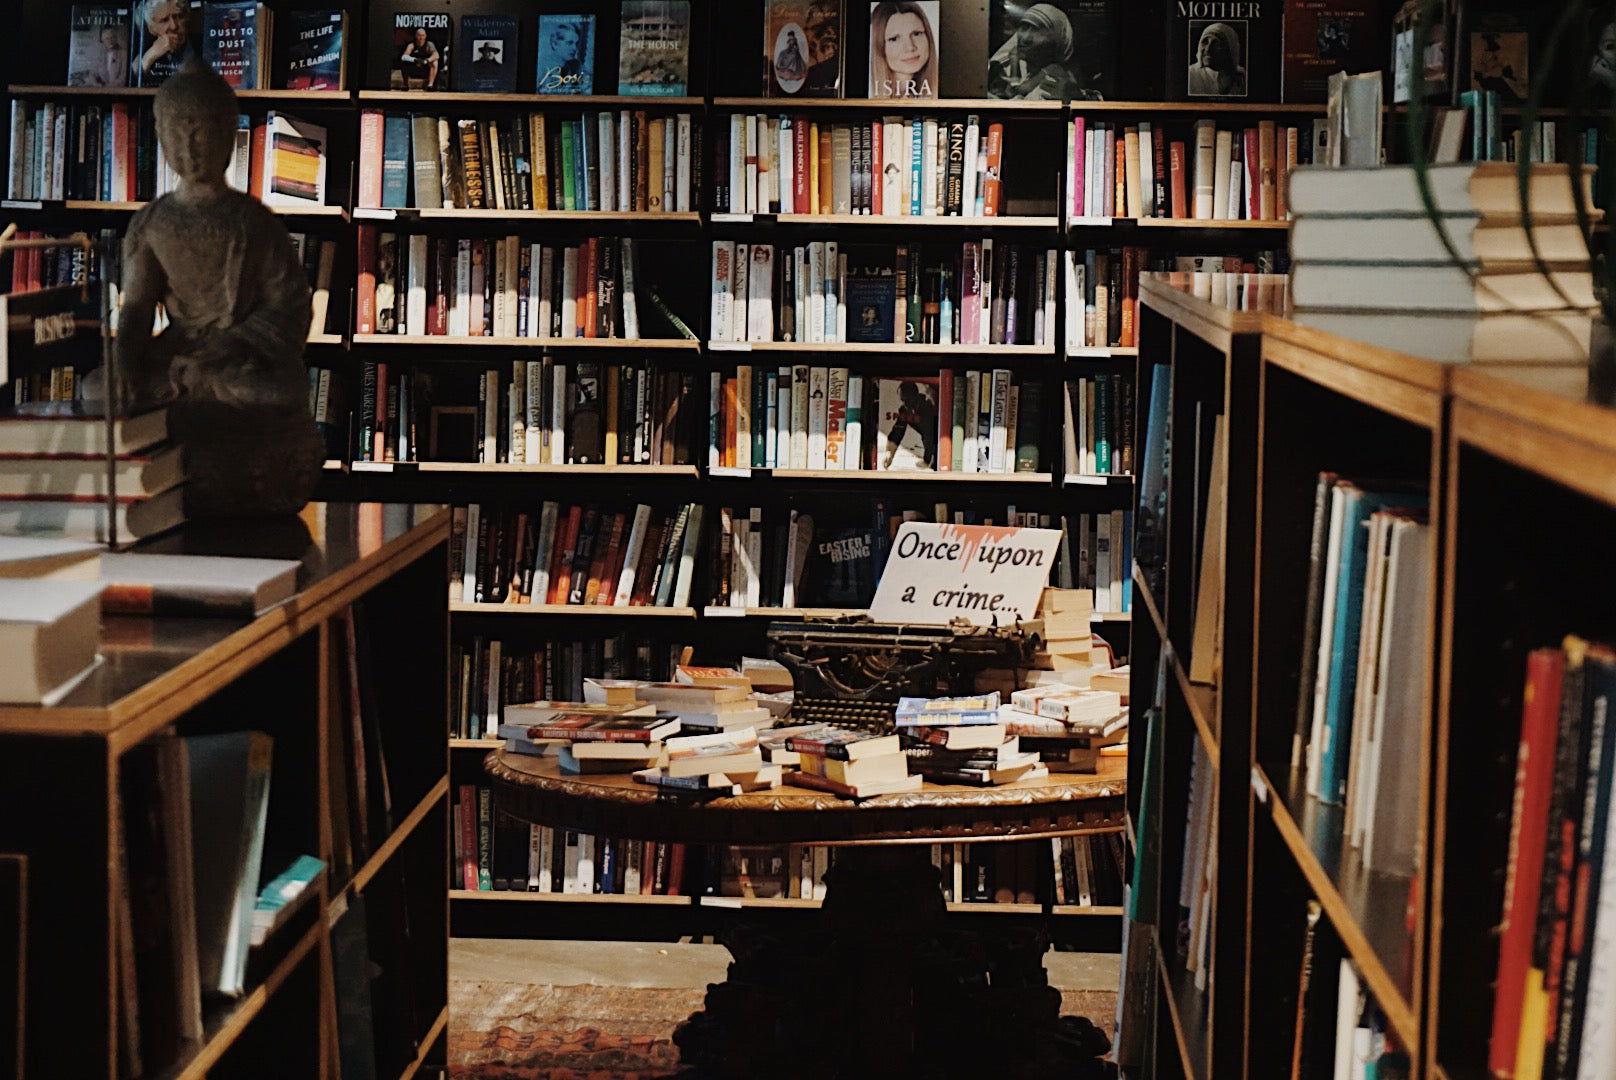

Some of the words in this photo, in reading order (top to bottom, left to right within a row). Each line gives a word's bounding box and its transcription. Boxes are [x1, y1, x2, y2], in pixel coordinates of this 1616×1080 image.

[1175, 0, 1262, 18] MOTHER
[395, 14, 410, 28] NO
[423, 14, 449, 28] FEAR
[463, 18, 517, 28] Wilderness
[209, 27, 238, 38] DUST
[240, 26, 255, 37] TO
[300, 29, 316, 41] THE
[316, 25, 334, 38] LIFE
[218, 39, 247, 49] DUST
[628, 40, 646, 50] THE
[648, 40, 681, 51] HOUSE
[211, 60, 251, 68] BENJAMIN
[290, 61, 298, 71] P.
[306, 52, 341, 67] BARNUM
[873, 78, 934, 97] ISIRA
[949, 123, 964, 161] KING
[462, 133, 484, 198] WITNESS
[947, 176, 955, 208] BLUNDELL
[364, 361, 375, 387] JAMES
[995, 378, 1006, 397] Lisle
[363, 388, 374, 420] FAIRFAX
[995, 398, 1006, 424] Letters
[827, 399, 845, 463] Mailer
[818, 536, 863, 556] EASTER
[830, 545, 872, 564] RISING
[897, 532, 961, 561] Once
[977, 544, 1045, 574] upon
[900, 585, 917, 604] a
[932, 583, 1019, 614] crime...
[542, 729, 568, 738] MURDER
